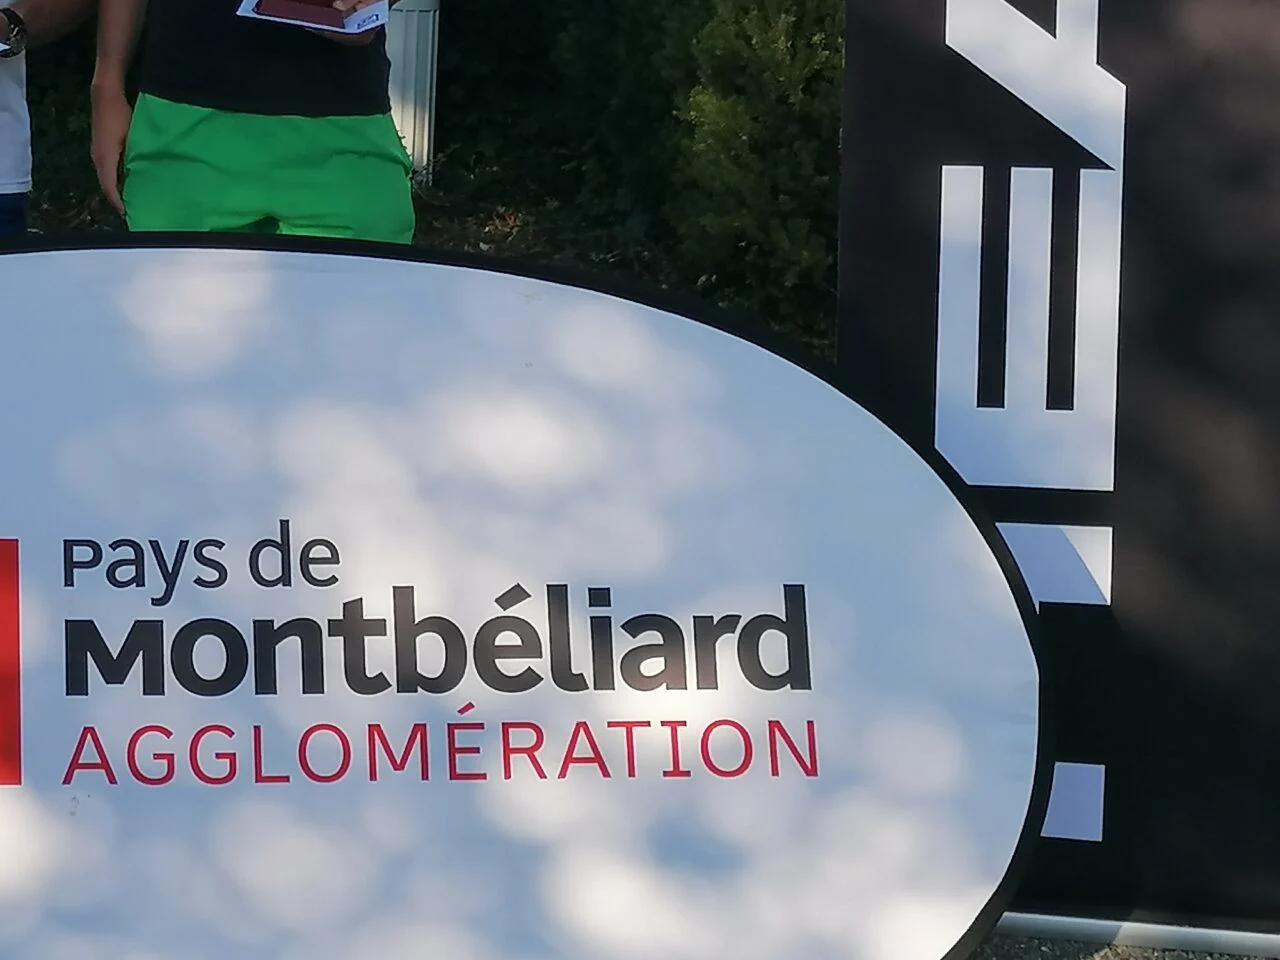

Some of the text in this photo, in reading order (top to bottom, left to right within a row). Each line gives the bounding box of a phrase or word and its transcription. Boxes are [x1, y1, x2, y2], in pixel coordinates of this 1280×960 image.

[63, 519, 341, 606] Pays de
[64, 583, 812, 696] Montbéliard
[62, 701, 819, 786] AGGLOMÉRATION
